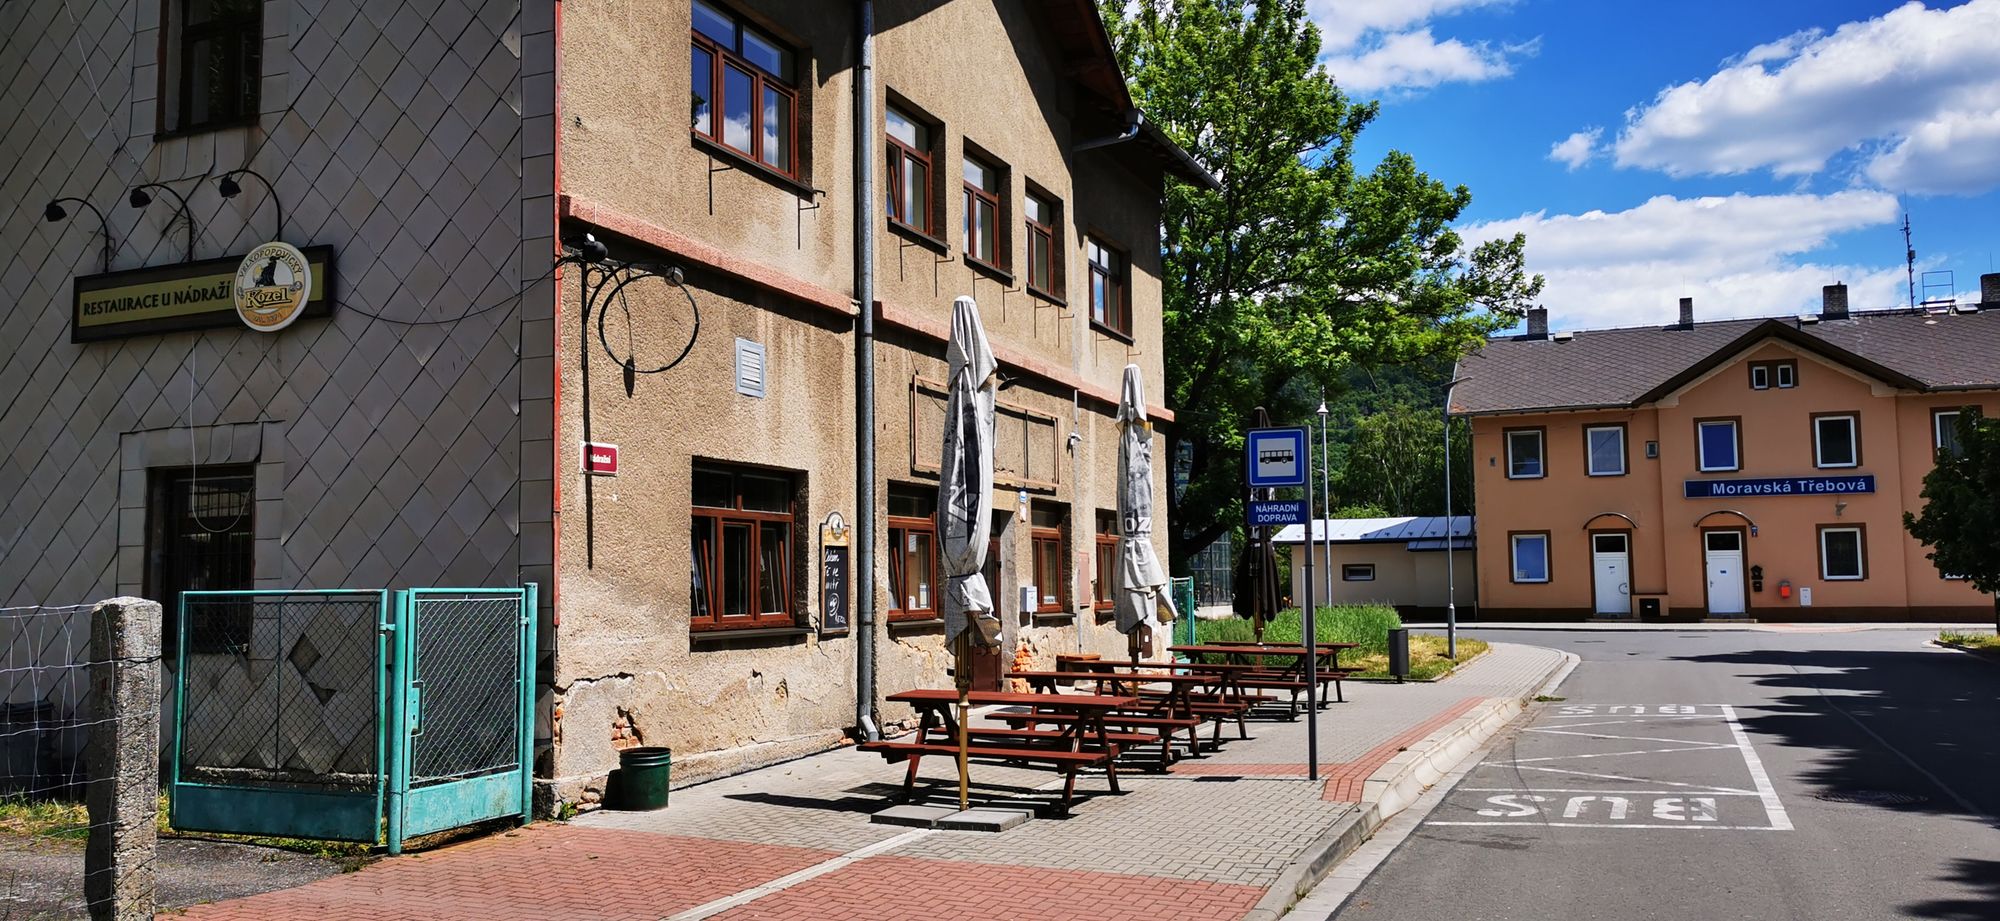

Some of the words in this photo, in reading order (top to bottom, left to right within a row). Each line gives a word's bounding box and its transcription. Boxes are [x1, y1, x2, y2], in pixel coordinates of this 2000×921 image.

[83, 295, 159, 316] RESTAURACE
[161, 294, 171, 306] U
[173, 280, 231, 305] NÁDRAŽÍ
[246, 287, 293, 309] Kozel
[1712, 481, 1791, 495] Moravská
[1797, 478, 1866, 492] Třebová
[1255, 502, 1300, 513] NÁHRADNÍ
[1257, 514, 1298, 523] DOPRAVA
[1557, 703, 1697, 714] BUS
[1476, 794, 1718, 821] BUS
